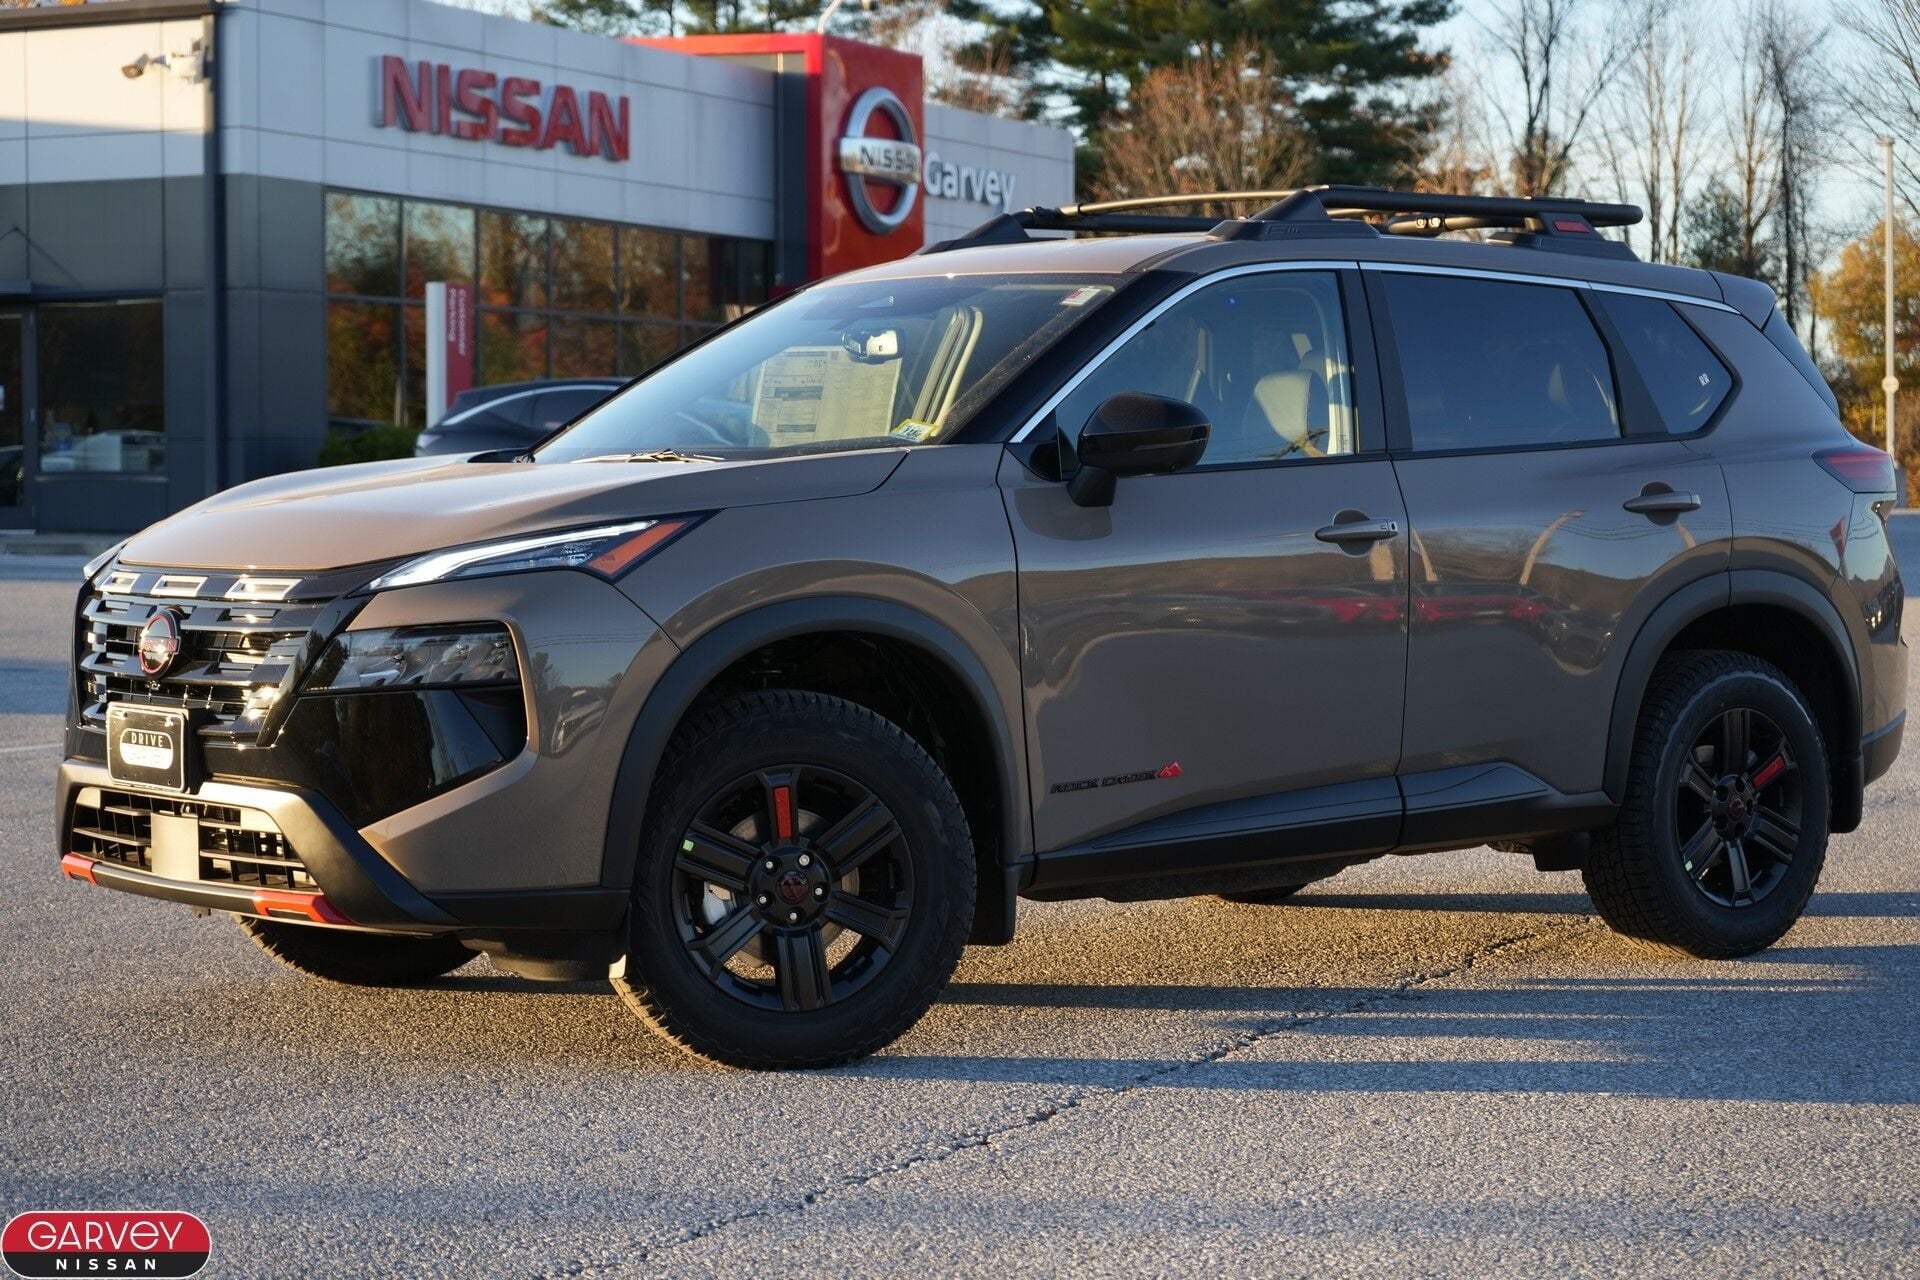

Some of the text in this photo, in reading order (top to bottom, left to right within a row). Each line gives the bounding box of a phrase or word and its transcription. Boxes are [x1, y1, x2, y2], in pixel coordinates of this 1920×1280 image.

[379, 54, 630, 161] NISSAN
[923, 152, 1017, 214] Garvey
[131, 732, 164, 748] DRIVE
